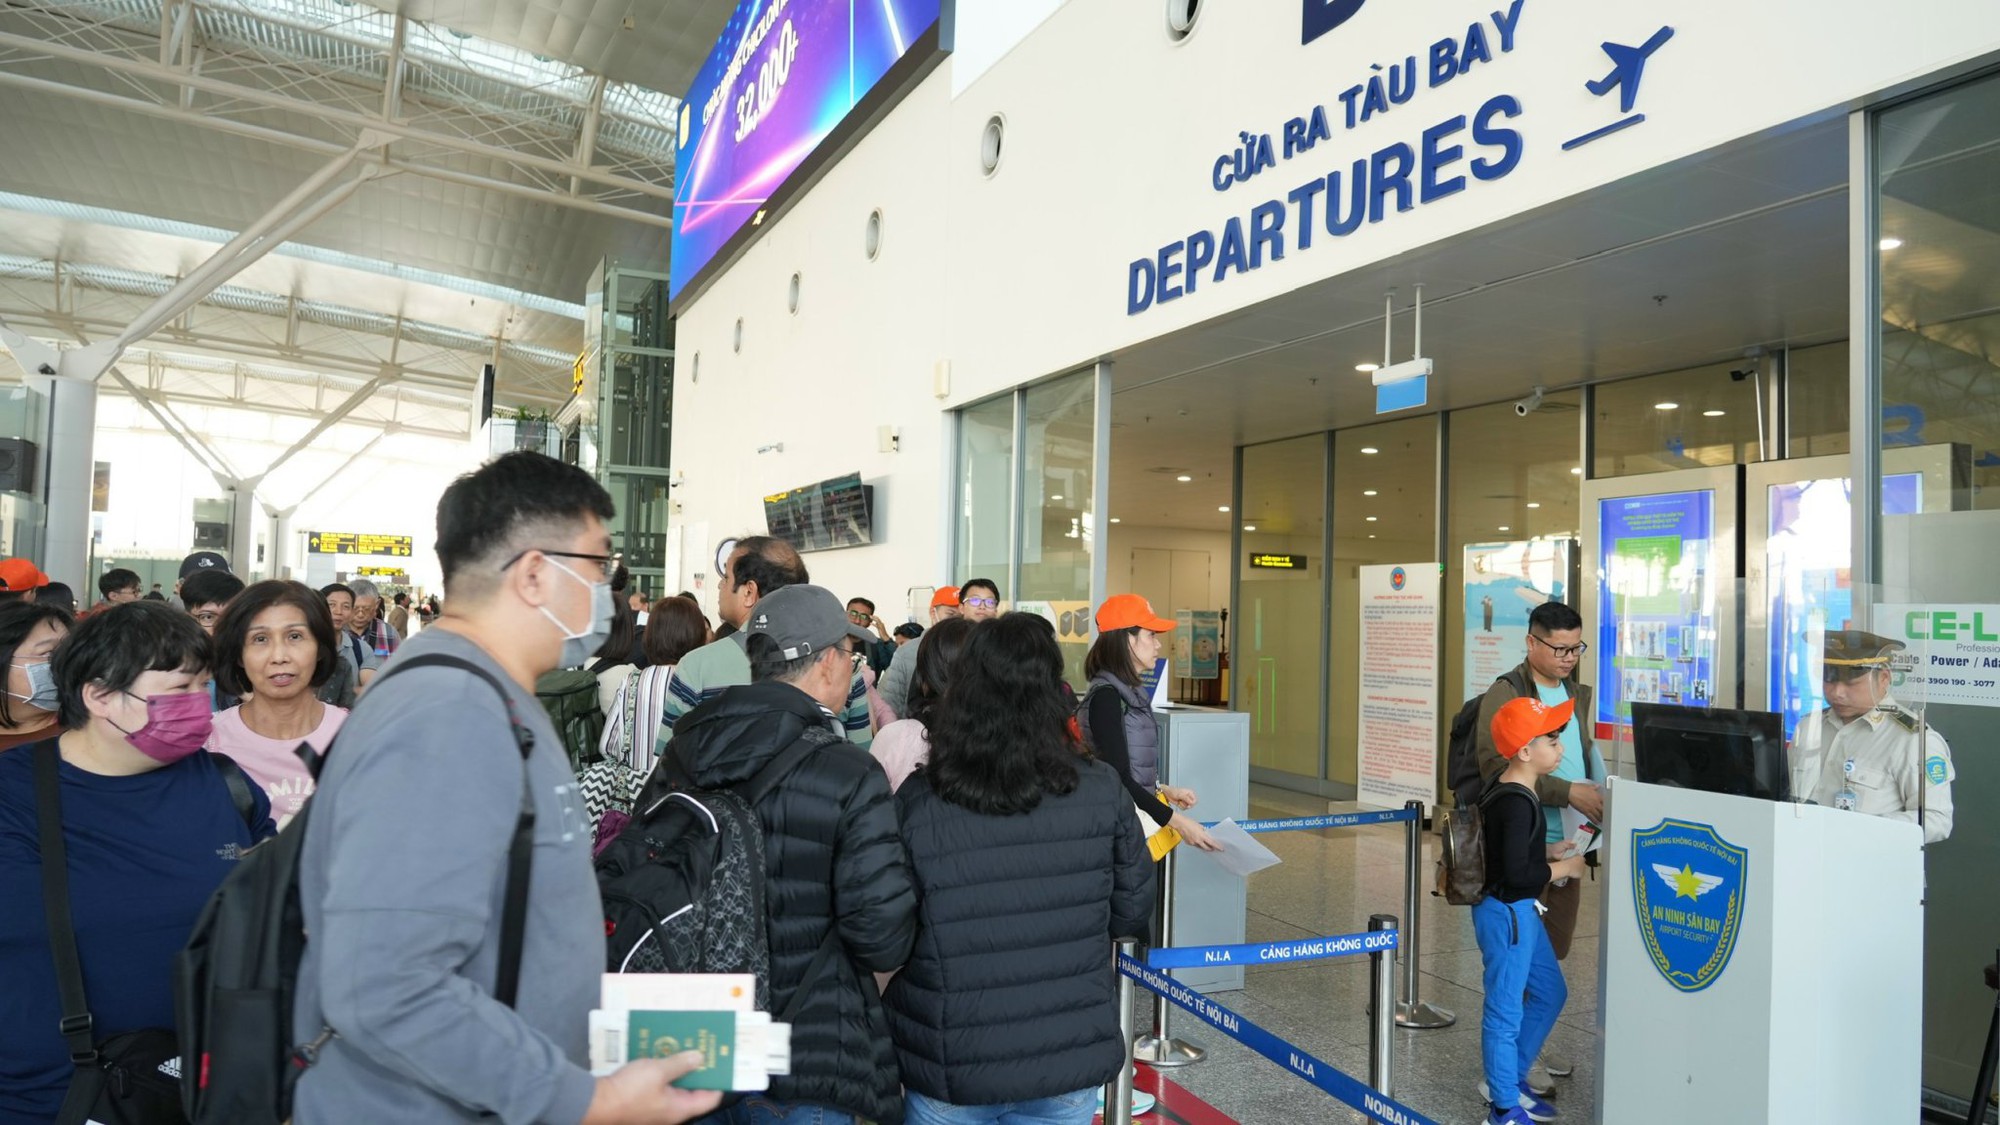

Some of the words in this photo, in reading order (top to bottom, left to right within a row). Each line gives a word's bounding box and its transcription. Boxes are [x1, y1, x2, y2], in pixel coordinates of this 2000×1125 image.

[1212, 130, 1275, 192] CỬA
[1283, 104, 1331, 160] RA
[1339, 56, 1417, 129] TÀU
[1429, 0, 1526, 88] BAY
[1127, 93, 1524, 316] DEPARTURES
[1931, 655, 1969, 667] Power
[1973, 657, 1979, 668] /
[1928, 677, 1949, 685] 3900
[1951, 678, 1966, 686] 190
[1973, 679, 1995, 688] 3077
[1379, 812, 1394, 820] N.I.A
[1652, 905, 1665, 920] AN
[1665, 907, 1686, 926] NINH
[1686, 911, 1703, 930] SÂN
[1704, 917, 1721, 934] BAY
[1659, 924, 1682, 937] AIRPORT
[1682, 929, 1710, 944] SECURITY
[1205, 950, 1231, 962] N.I.A
[1260, 944, 1290, 960] CẢNG
[1325, 938, 1361, 954] KHÔNG
[1364, 931, 1393, 948] QUỐC
[1143, 969, 1169, 995] KHÔNG
[1170, 987, 1193, 1007] QUỐC
[1195, 998, 1207, 1014] TẾ
[1207, 1006, 1222, 1025] NỘI
[1290, 1052, 1315, 1079] N.I.A
[1364, 1093, 1408, 1125] NOIBAI
